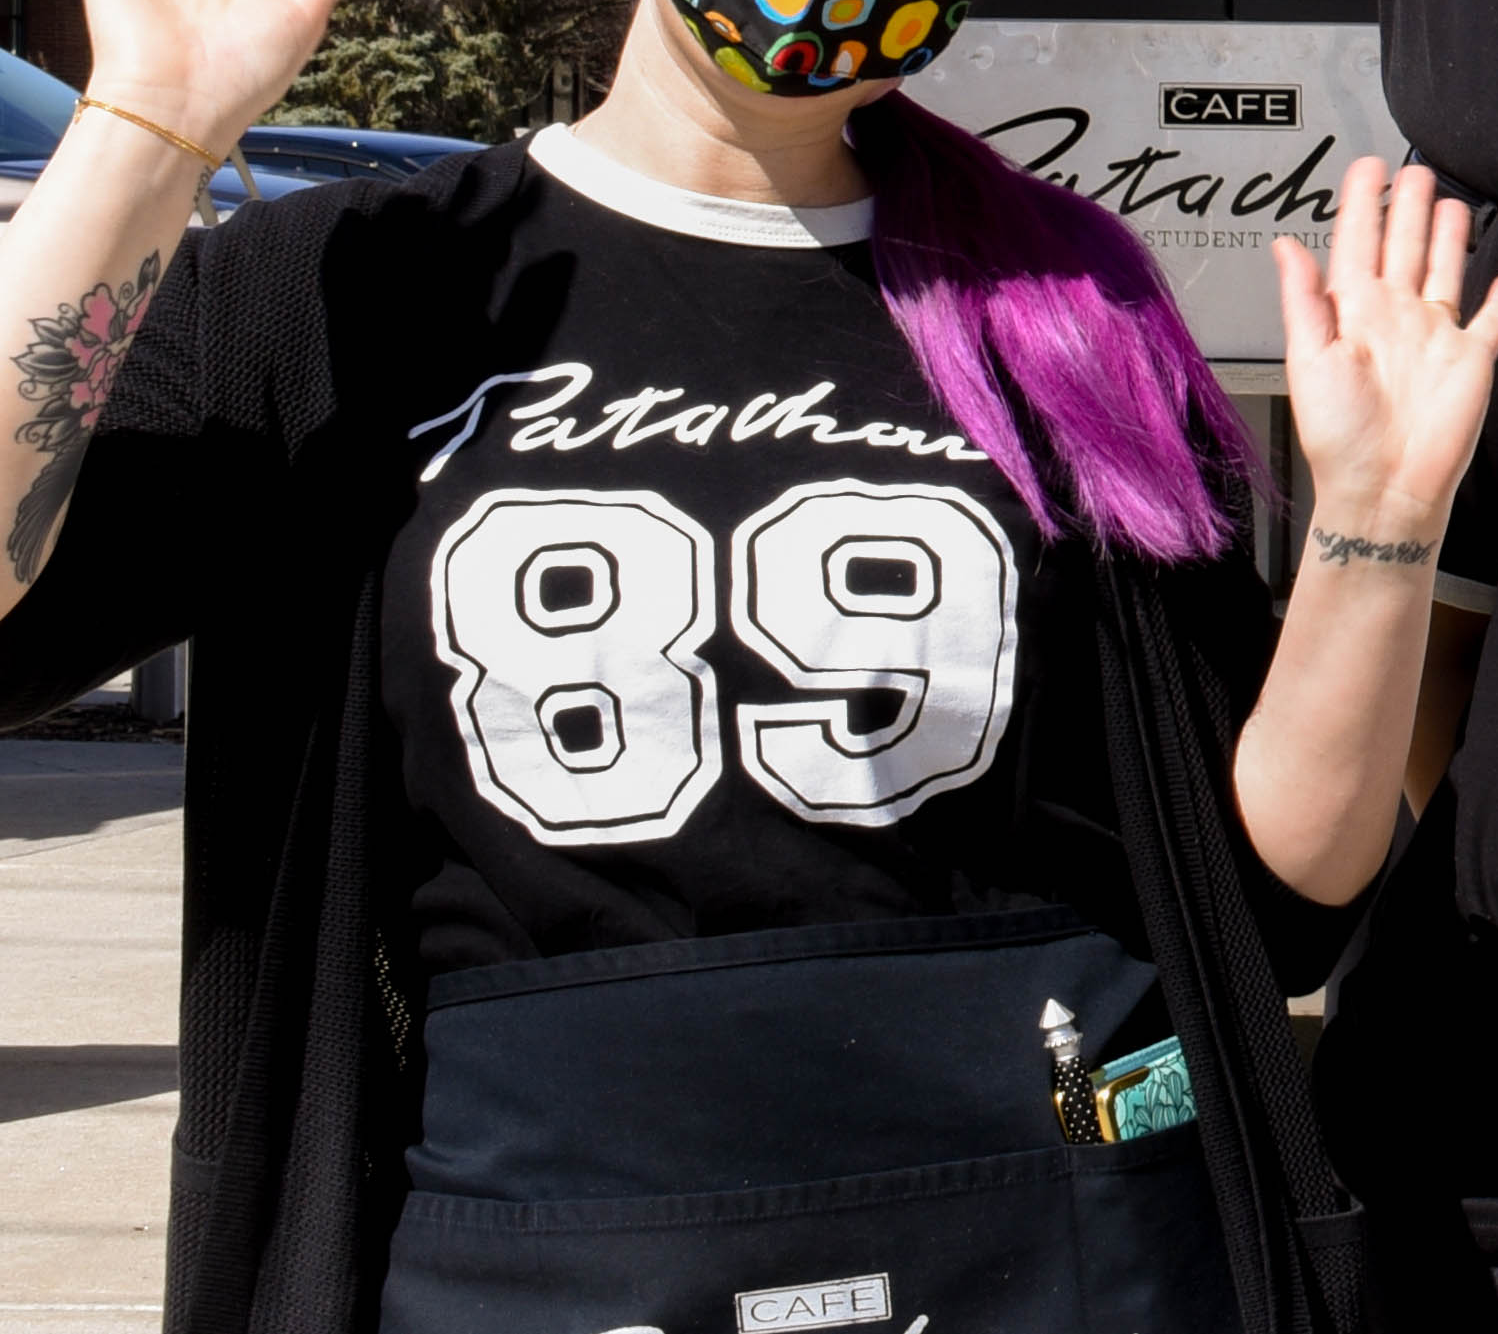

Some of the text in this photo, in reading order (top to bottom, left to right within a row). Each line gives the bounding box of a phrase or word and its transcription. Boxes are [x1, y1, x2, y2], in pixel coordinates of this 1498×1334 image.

[1169, 92, 1291, 122] CAFE
[1143, 230, 1335, 249] STUDENT NIO
[407, 362, 988, 483] Patachou
[431, 478, 1020, 848] 89
[750, 1286, 878, 1323] CAFE
